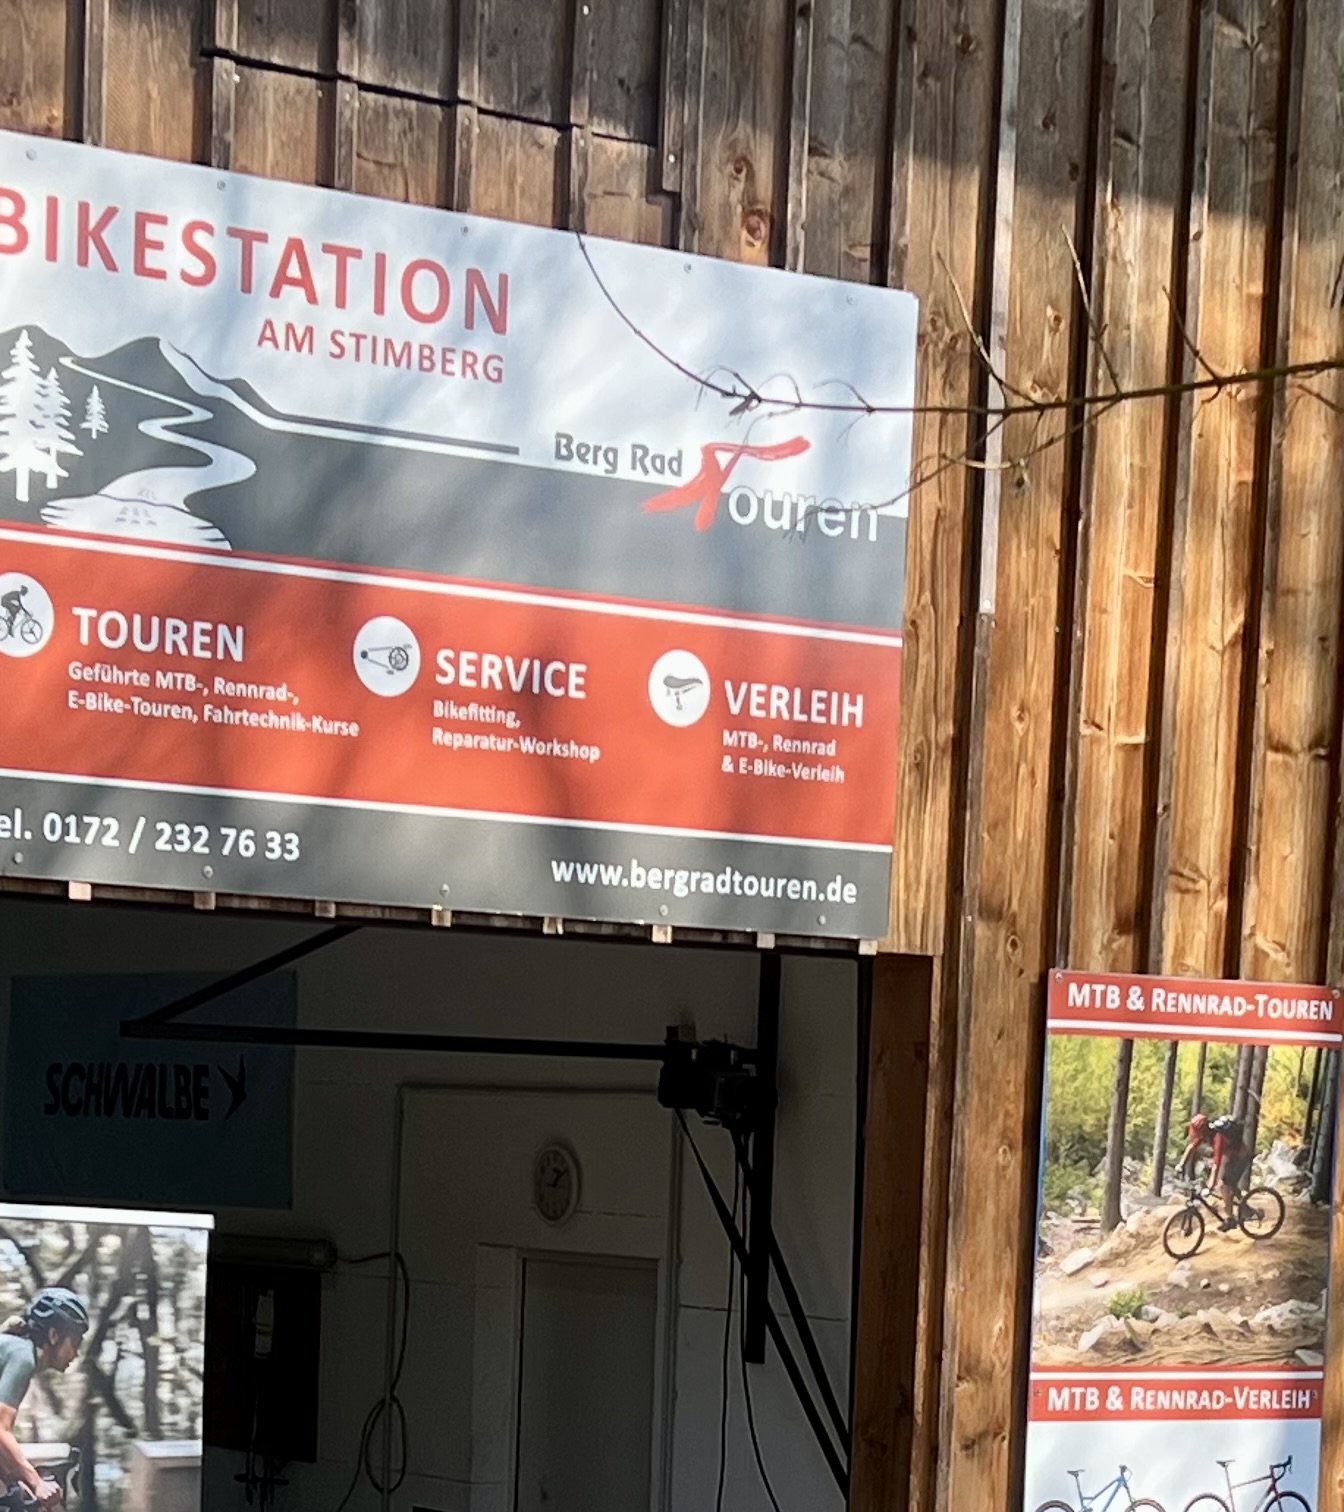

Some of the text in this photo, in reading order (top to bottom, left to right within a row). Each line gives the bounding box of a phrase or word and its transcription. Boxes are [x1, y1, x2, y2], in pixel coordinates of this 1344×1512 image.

[257, 318, 505, 383] AM STIMBERG
[554, 432, 619, 474] Berg
[630, 443, 683, 477] Rad
[72, 606, 246, 662] TOUREN
[67, 660, 299, 704] Geführte MTB-, Rennrad-,
[435, 649, 588, 700] SERVICE
[67, 690, 360, 737] E-Bike-Touren, Fahrtechnik-Kurse
[432, 700, 521, 728] Bikefitting,
[723, 679, 864, 728] VERLEIH
[432, 727, 600, 763] Reparatur-Workshop
[722, 729, 836, 757] MTB-, Rennrad
[721, 756, 845, 784] & E-Bike-Verleih
[43, 812, 119, 848] 0172
[128, 816, 147, 854] /
[155, 821, 210, 855] 232
[220, 827, 256, 859] 76
[265, 831, 300, 862] 33
[552, 859, 857, 904] www.bergradtouren.de
[1067, 982, 1120, 1010] MTB
[1126, 986, 1145, 1012] &
[44, 1063, 209, 1121] SCHWALBE
[1047, 1386, 1099, 1411] MTB
[1105, 1385, 1124, 1411] &
